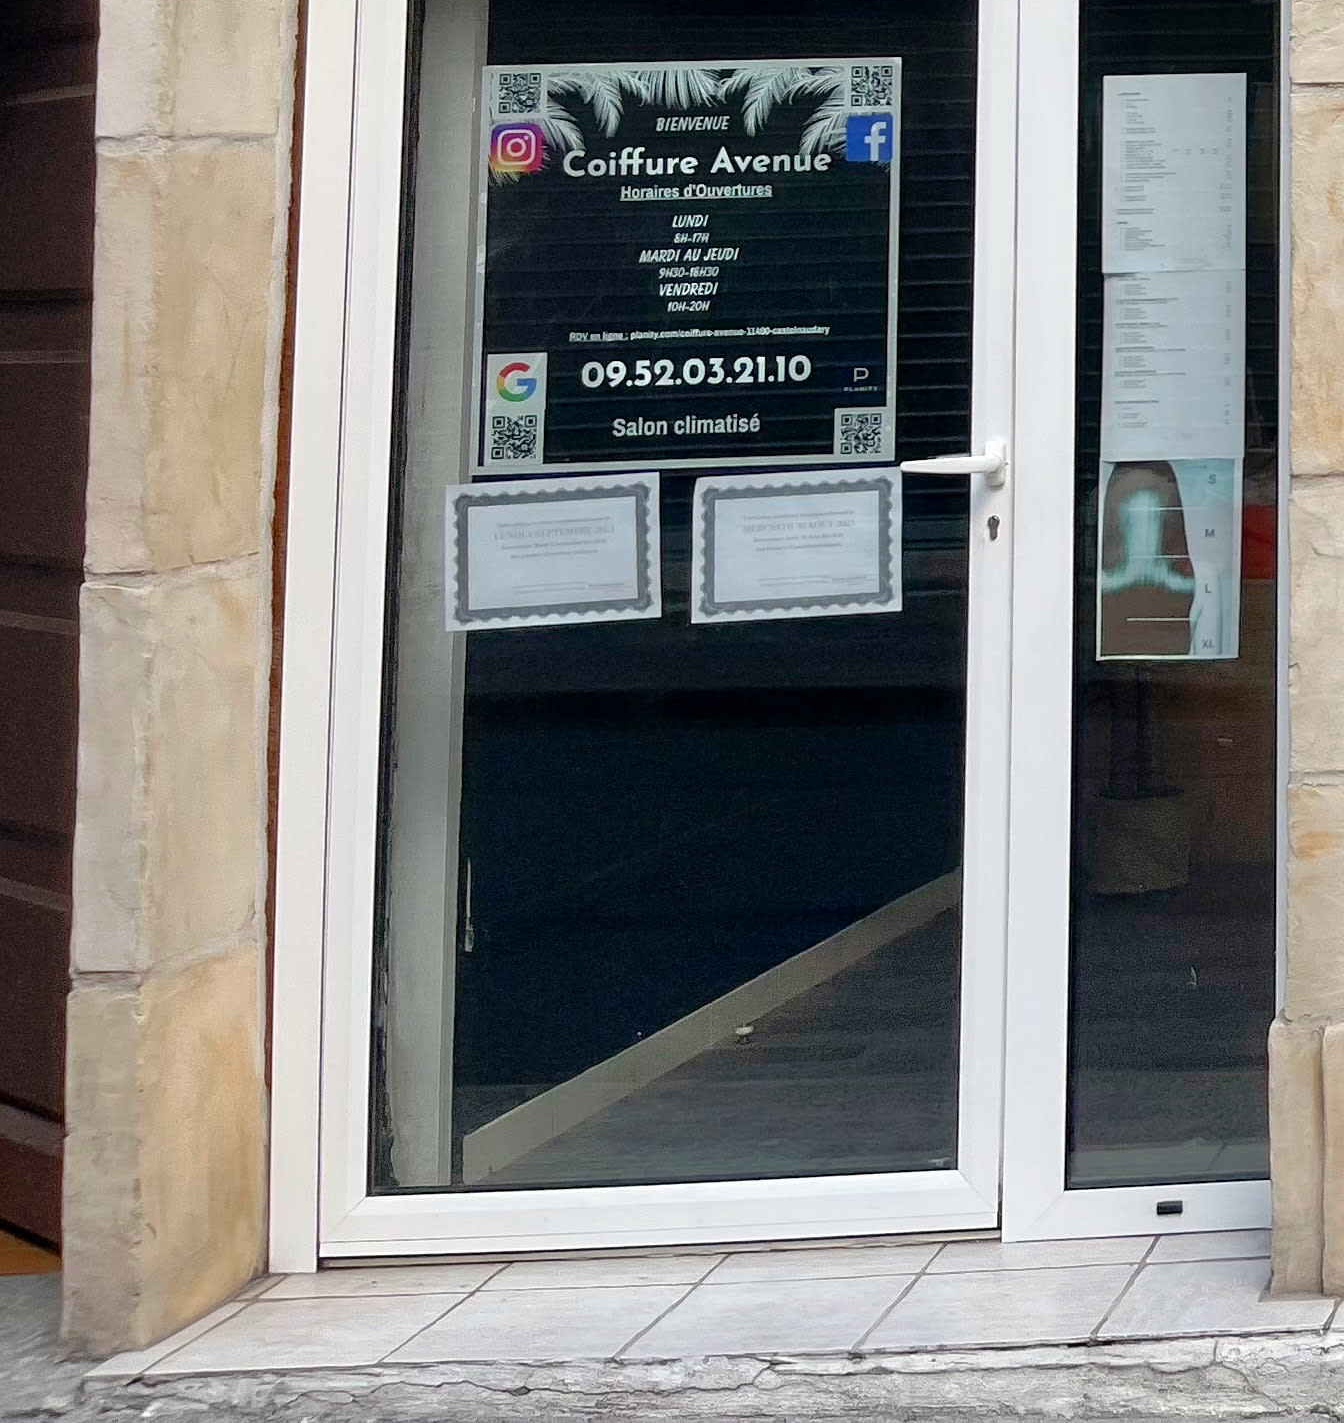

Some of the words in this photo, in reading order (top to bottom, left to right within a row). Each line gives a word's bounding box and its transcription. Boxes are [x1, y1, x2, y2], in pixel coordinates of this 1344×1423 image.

[656, 115, 731, 132] BIENVENUE
[562, 146, 699, 177] Coiffure
[710, 145, 832, 174] Avenue
[621, 185, 680, 200] Horaires
[684, 183, 773, 198] d'Ouvertures
[672, 214, 709, 228] LUNDI
[673, 232, 710, 244] 8H-17H
[639, 249, 681, 263] MARDI
[683, 248, 702, 262] AU
[703, 247, 740, 261] JEUDI
[659, 281, 719, 296] VENDREDI
[667, 300, 711, 312] 10H-20H
[581, 355, 812, 388] 09.52.03.21.10
[612, 415, 668, 437] Salon
[675, 412, 761, 435] climatisé
[1204, 528, 1215, 538] M
[1204, 583, 1212, 594] L
[1201, 639, 1214, 648] XL
